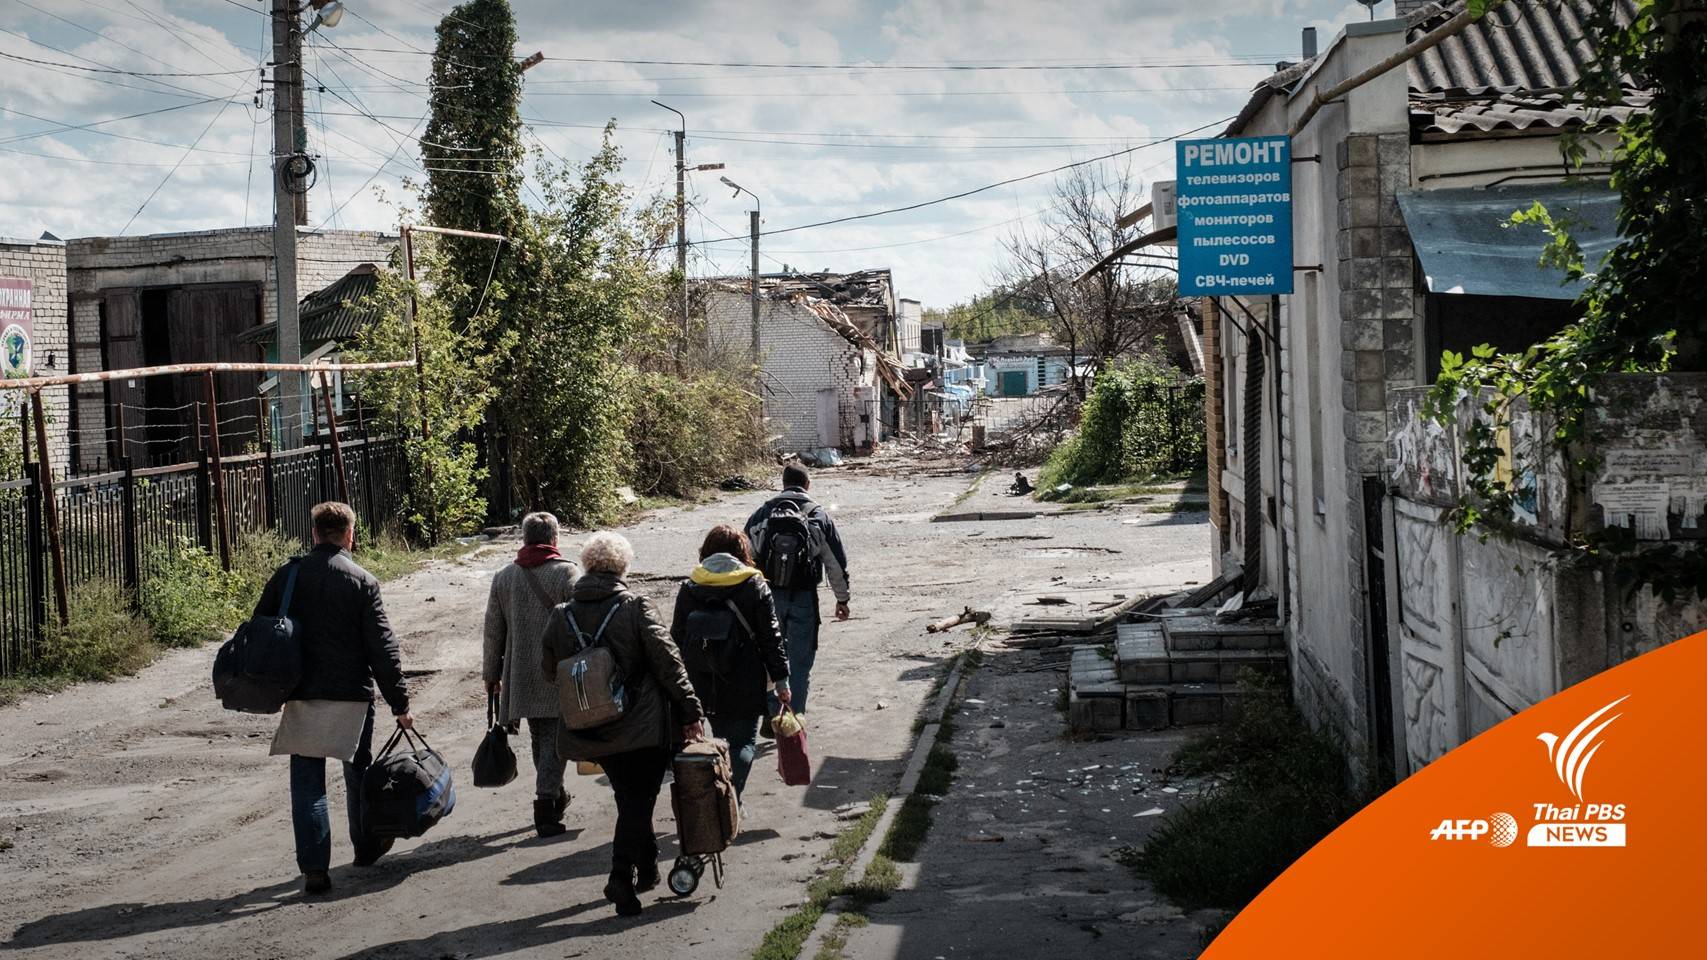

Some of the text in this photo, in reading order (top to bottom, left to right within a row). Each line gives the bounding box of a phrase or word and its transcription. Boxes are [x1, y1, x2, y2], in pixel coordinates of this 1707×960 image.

[1184, 141, 1285, 167] РЕМОНТ
[1186, 172, 1280, 186] телевизоров
[1177, 192, 1291, 208] фотоаппаратов
[1194, 213, 1274, 227] мониторов
[1193, 234, 1276, 247] пылесосов
[1219, 254, 1250, 266] DVD
[1195, 273, 1275, 288] СВЧ-печей
